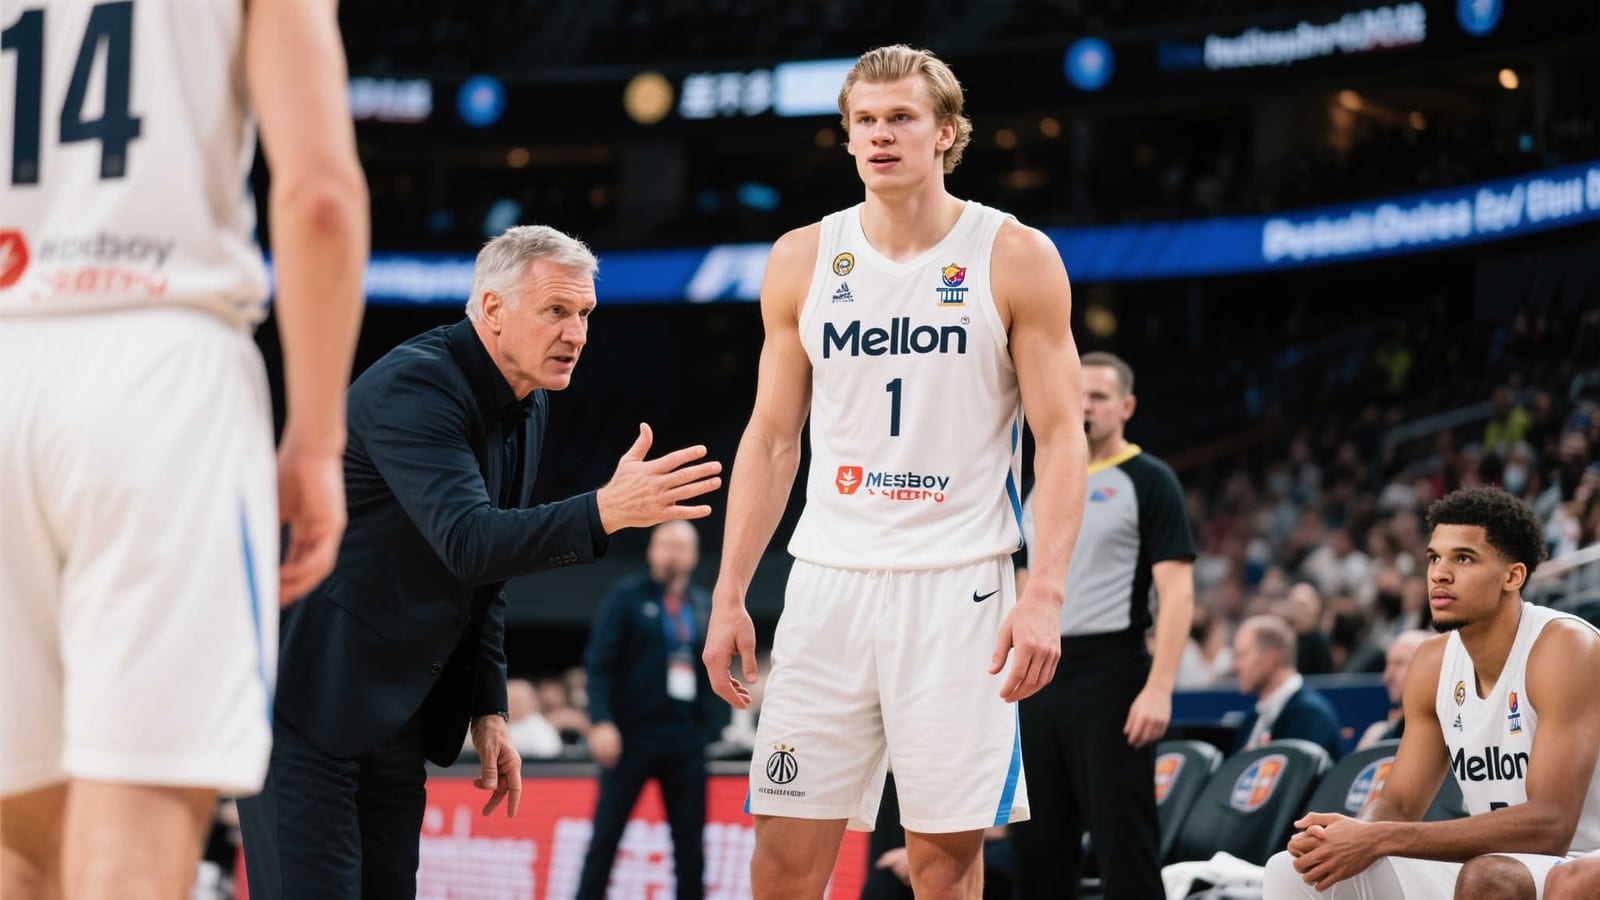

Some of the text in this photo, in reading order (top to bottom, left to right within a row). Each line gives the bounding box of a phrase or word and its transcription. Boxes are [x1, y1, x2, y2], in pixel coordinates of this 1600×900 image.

[1, 1, 142, 186] 14
[823, 317, 967, 359] Mellon
[886, 378, 902, 437] 1
[1447, 744, 1530, 782] Mellon
